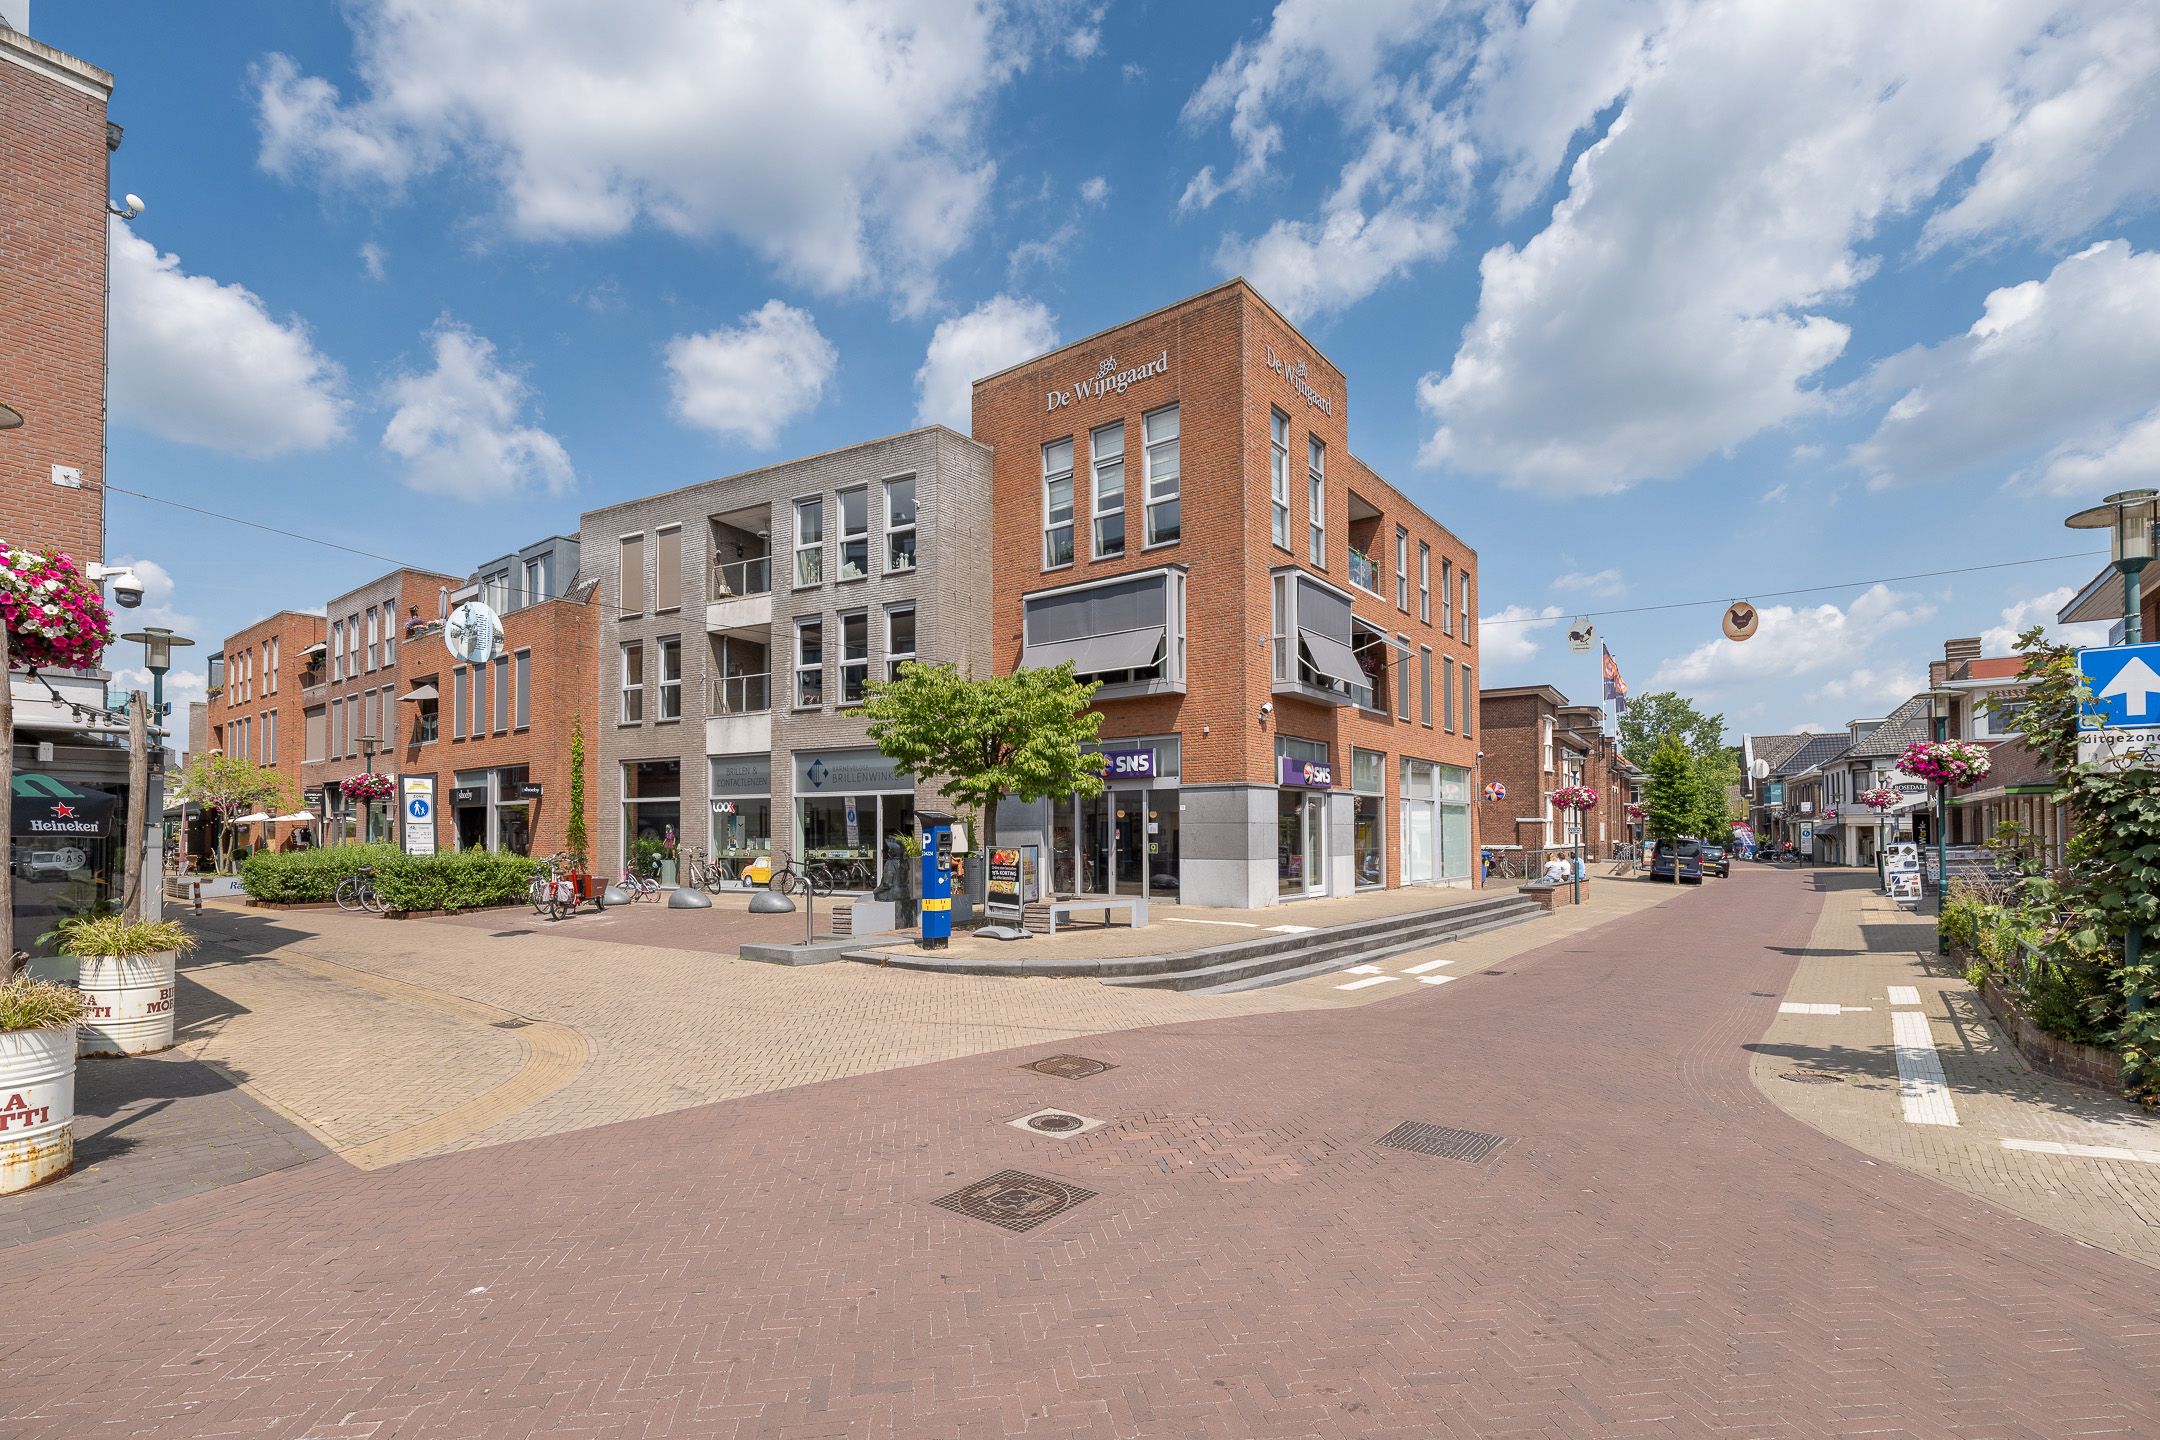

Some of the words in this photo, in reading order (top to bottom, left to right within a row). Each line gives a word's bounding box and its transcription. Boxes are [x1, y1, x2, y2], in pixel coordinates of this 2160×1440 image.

[1046, 390, 1070, 411] De
[1073, 350, 1168, 400] Wijngaard
[1267, 345, 1281, 374] De
[1284, 359, 1331, 416] Wijngaard
[727, 766, 750, 776] BRILLEN
[753, 766, 757, 775] &
[1116, 754, 1149, 772] SNS
[717, 777, 767, 787] CONTACTLENZEN
[1314, 766, 1330, 783] SNS
[30, 820, 98, 832] Heineken
[922, 833, 932, 849] P
